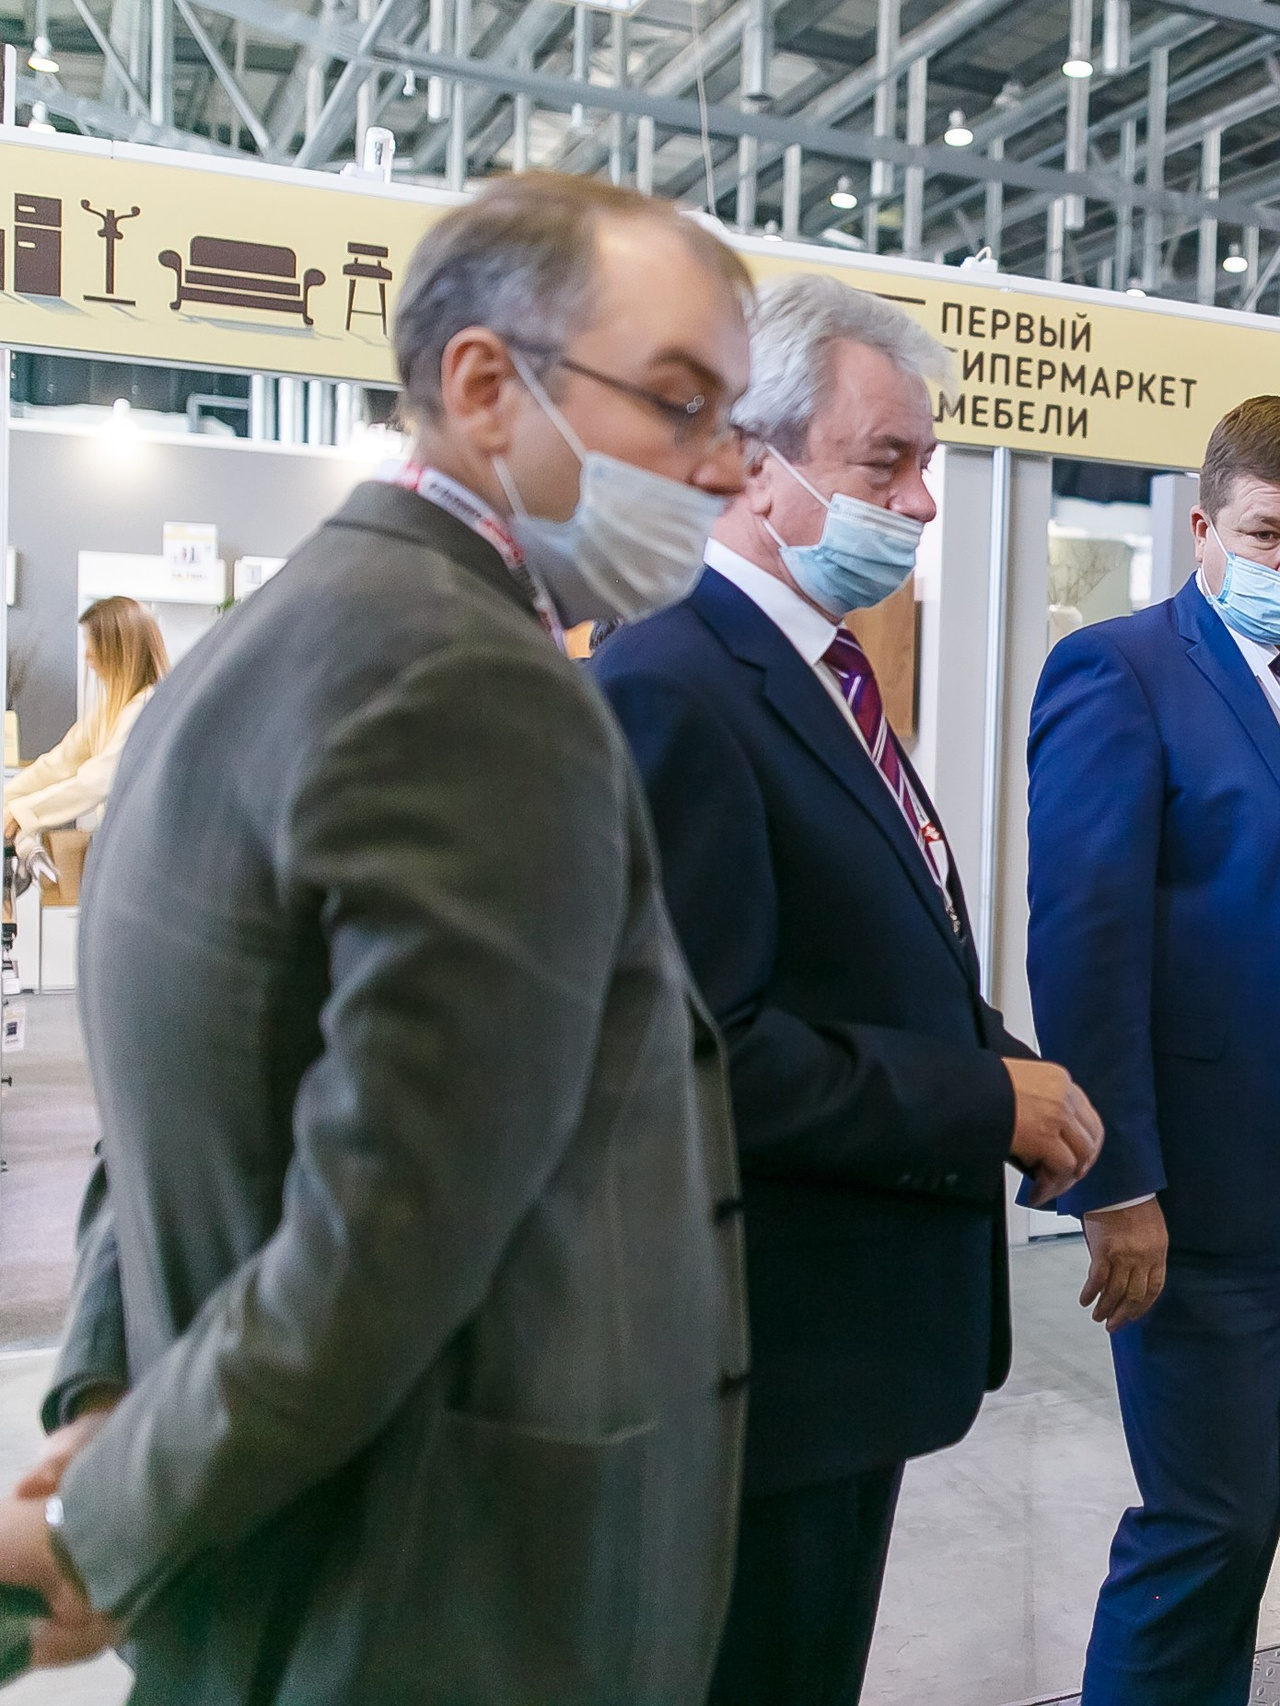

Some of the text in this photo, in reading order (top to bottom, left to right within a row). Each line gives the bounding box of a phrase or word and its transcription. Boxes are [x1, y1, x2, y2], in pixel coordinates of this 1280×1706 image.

[942, 301, 1092, 352] ПЕРВЫЙ
[945, 345, 1197, 408] ИПЕРМАРКЕТ
[935, 391, 1088, 438] МЕБЕЛИ
